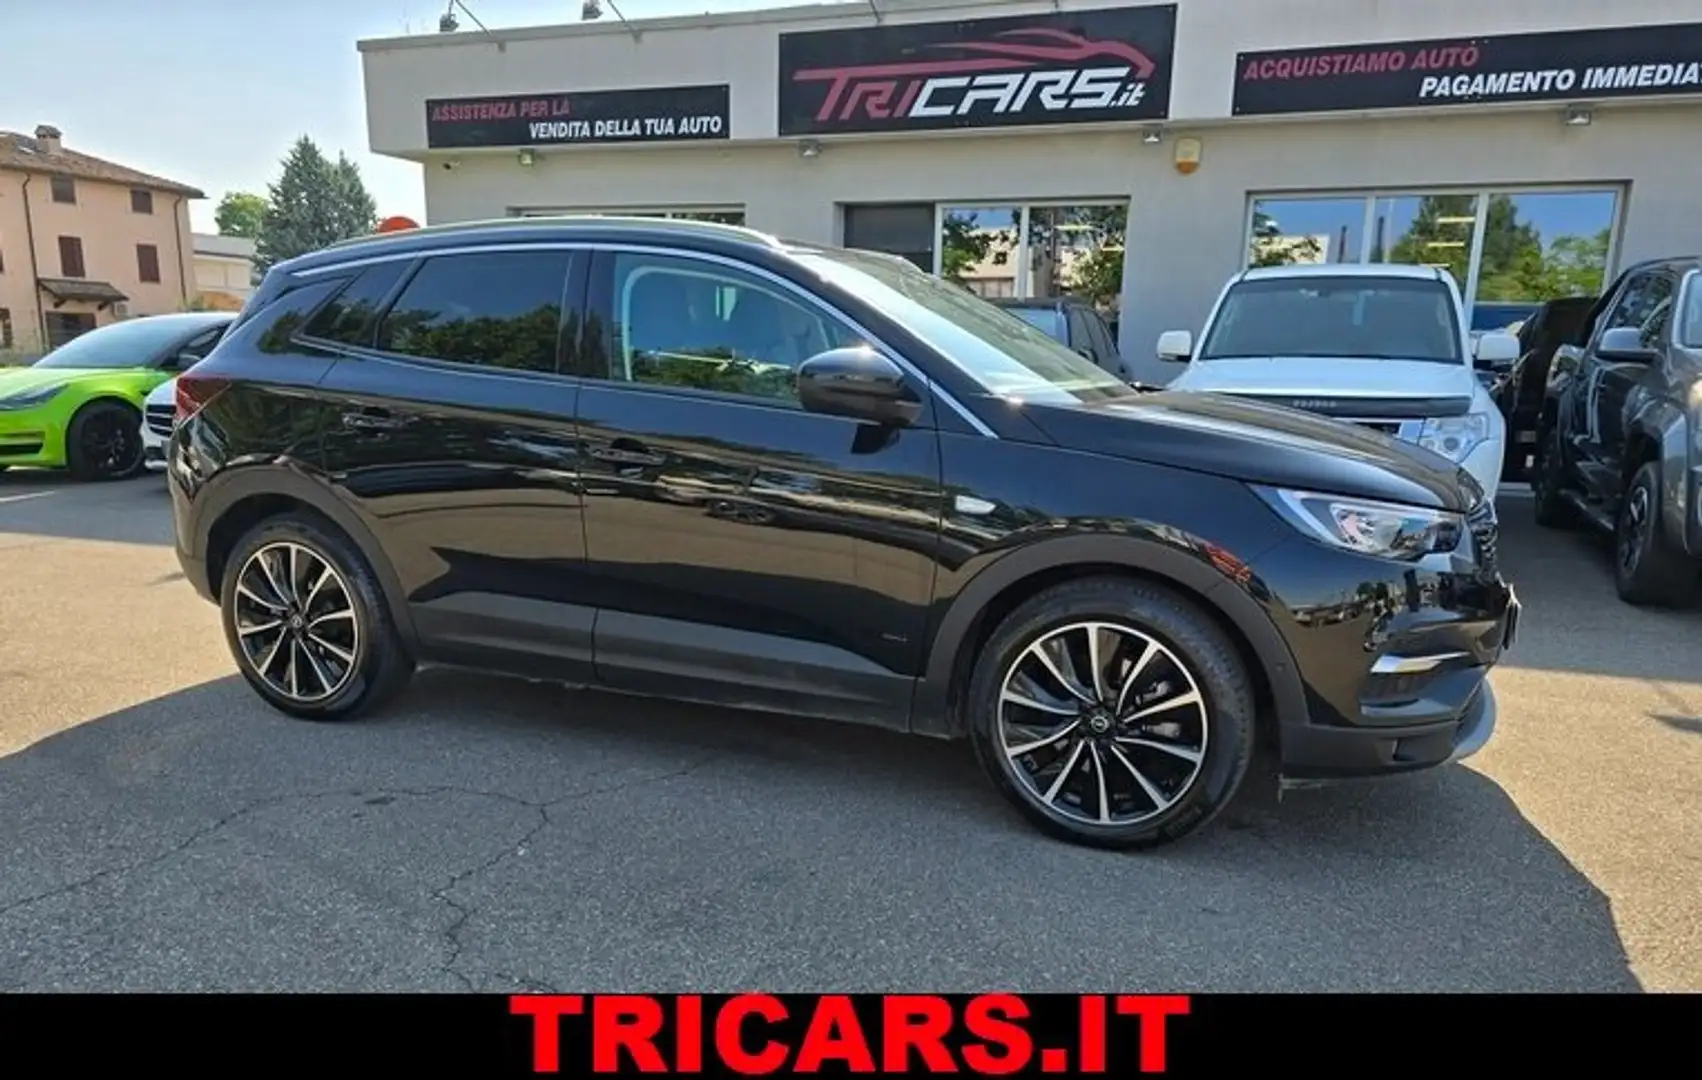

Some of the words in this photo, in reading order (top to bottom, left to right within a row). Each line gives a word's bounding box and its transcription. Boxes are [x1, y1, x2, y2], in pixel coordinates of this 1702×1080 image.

[1243, 51, 1406, 80] ACQUISTIAMO
[1411, 46, 1480, 70] AUTO
[1419, 69, 1576, 98] PAGAMENTO
[1581, 61, 1702, 90] IMMEDIA
[432, 102, 517, 121] ASSISTENZA
[520, 100, 548, 117] PER
[552, 97, 570, 115] LA
[529, 121, 591, 139] VENDITA
[594, 118, 642, 137] DELLA
[645, 117, 675, 136] TUA
[678, 115, 722, 134] AUTO
